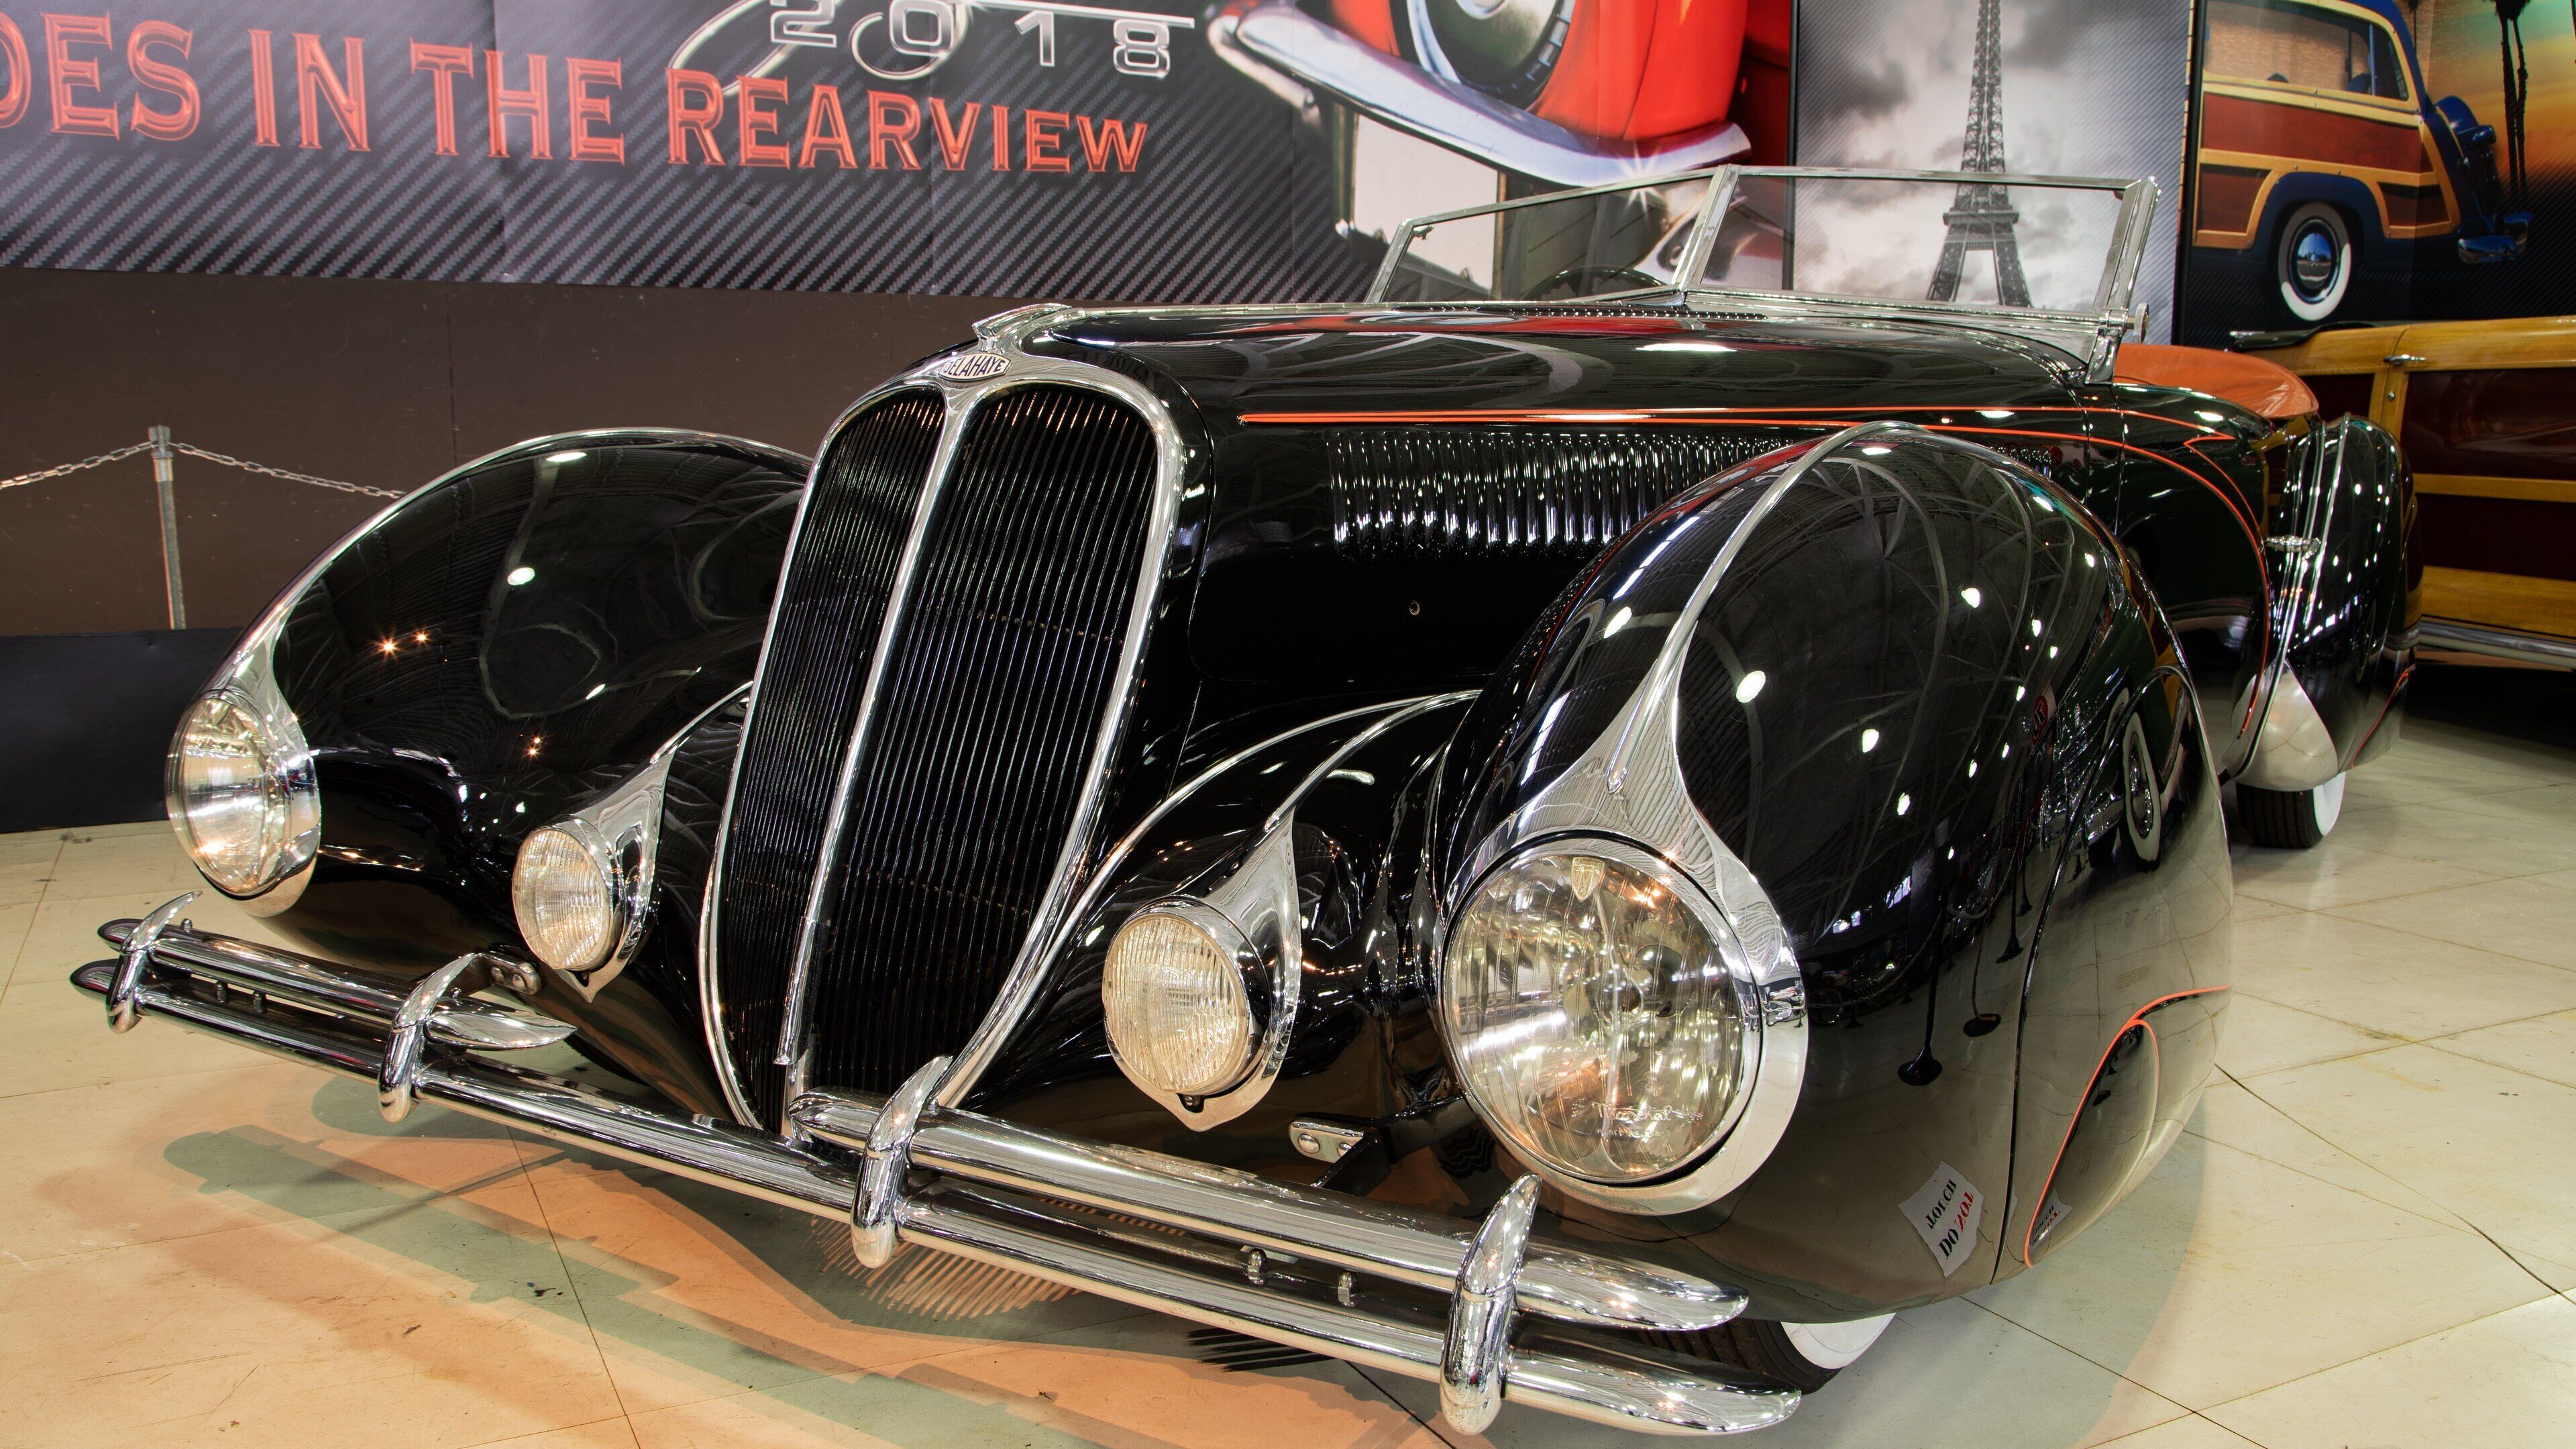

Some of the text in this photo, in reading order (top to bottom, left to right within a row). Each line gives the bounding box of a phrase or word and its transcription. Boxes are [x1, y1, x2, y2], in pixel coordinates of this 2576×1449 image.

[770, 0, 1171, 78] 2018
[248, 29, 372, 152] IN
[410, 38, 626, 165] THE
[666, 67, 1148, 173] REARVIEW
